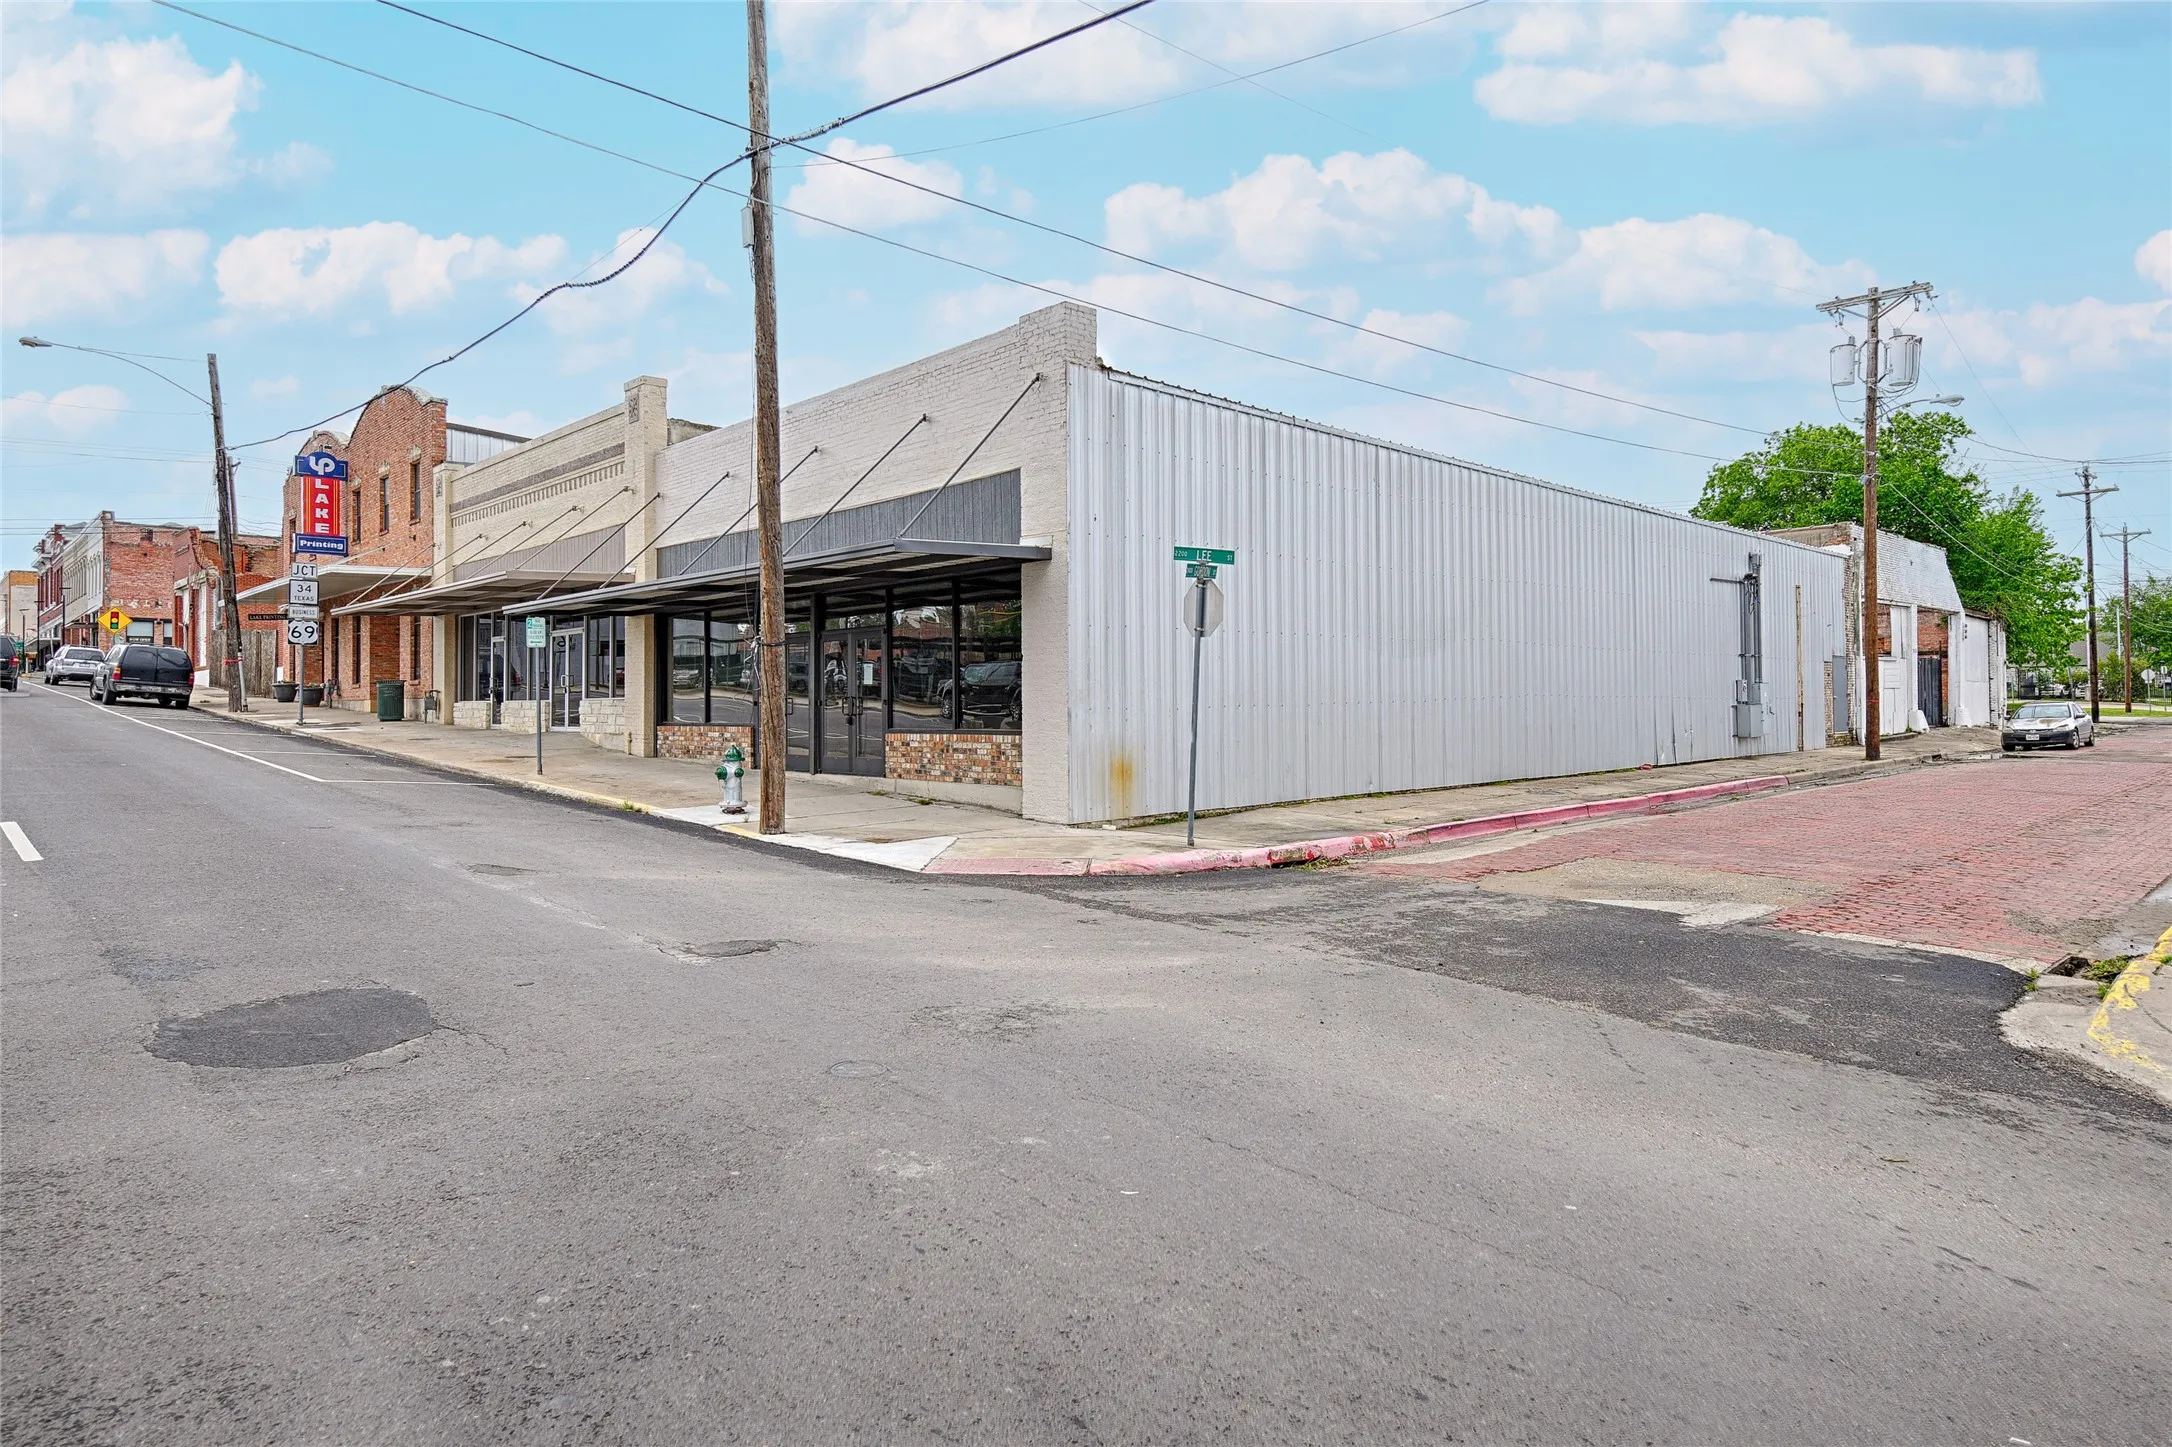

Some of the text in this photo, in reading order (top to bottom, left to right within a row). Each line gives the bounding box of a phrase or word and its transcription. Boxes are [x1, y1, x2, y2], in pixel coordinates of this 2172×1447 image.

[315, 478, 329, 533] LAKE
[300, 540, 343, 549] Printing
[1196, 550, 1212, 561] LEE
[293, 565, 316, 576] JCT
[296, 584, 312, 593] 34
[291, 625, 315, 639] 69
